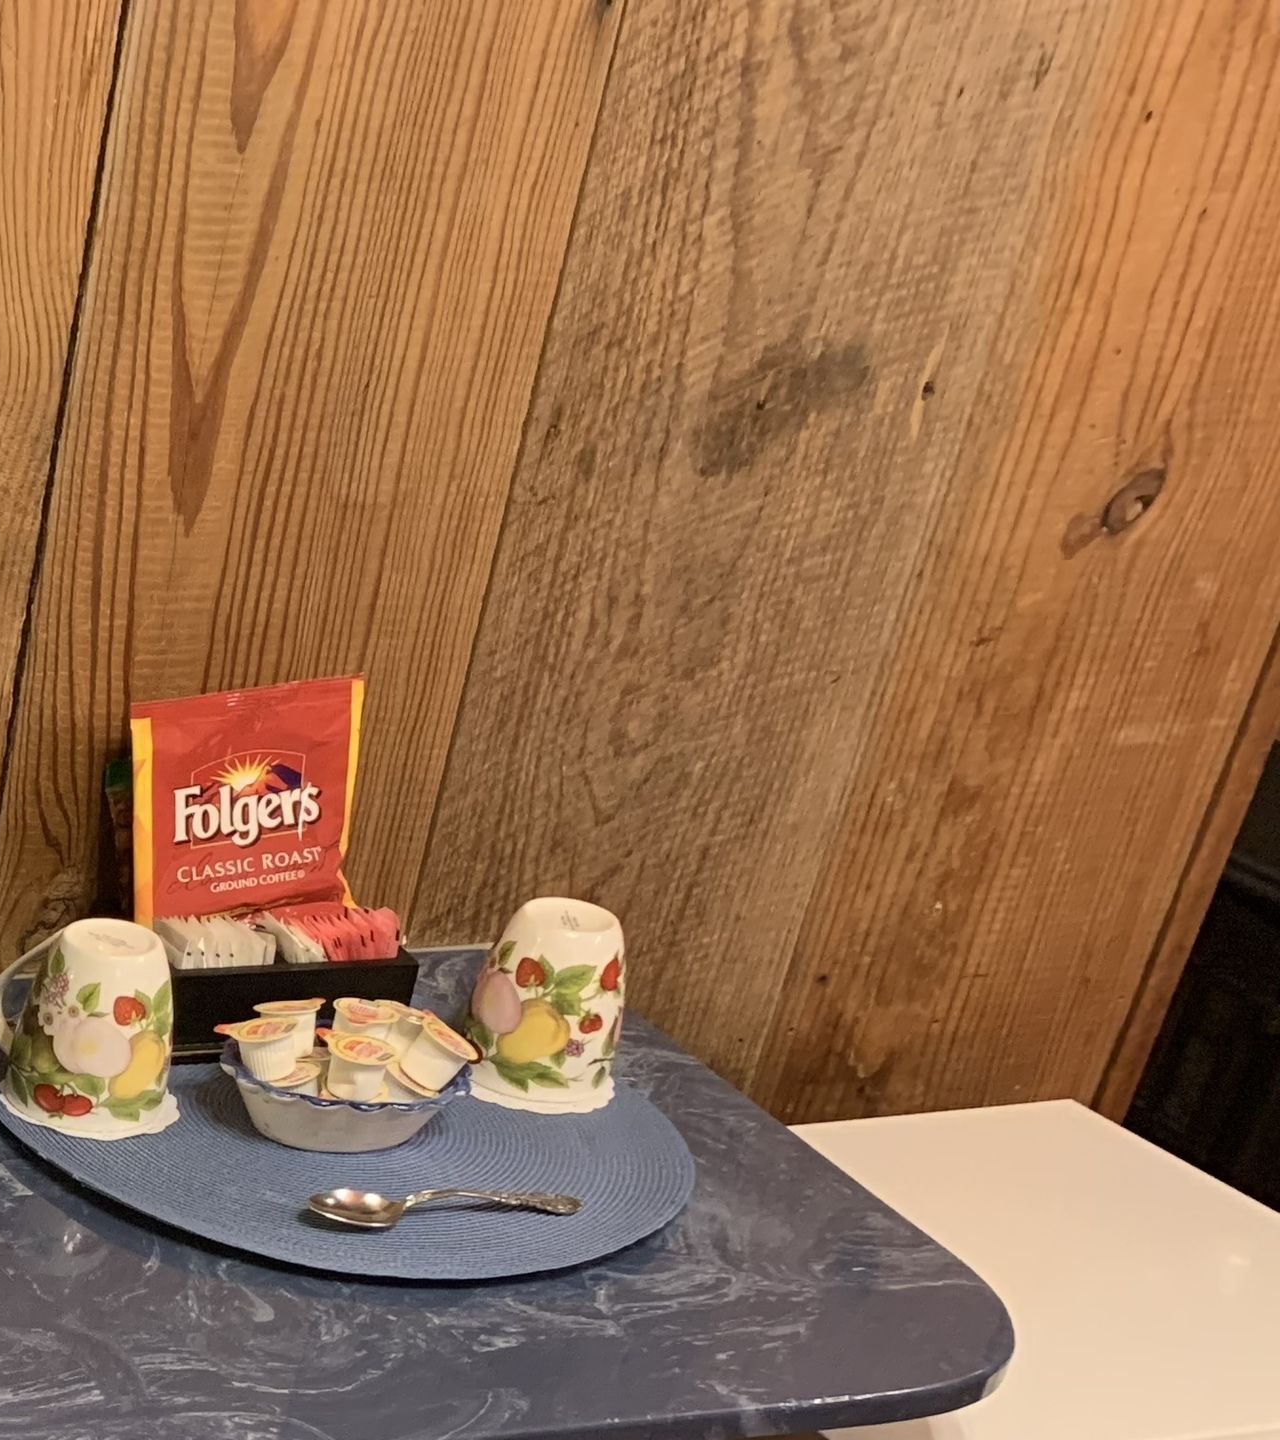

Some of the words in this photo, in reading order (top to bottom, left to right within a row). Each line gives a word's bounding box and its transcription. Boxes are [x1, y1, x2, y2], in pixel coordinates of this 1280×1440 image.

[173, 782, 320, 847] Folgers
[176, 857, 255, 883] CLASSIC
[261, 847, 319, 870] ROAST
[210, 876, 258, 893] GROUND
[259, 871, 297, 886] COFFEE
